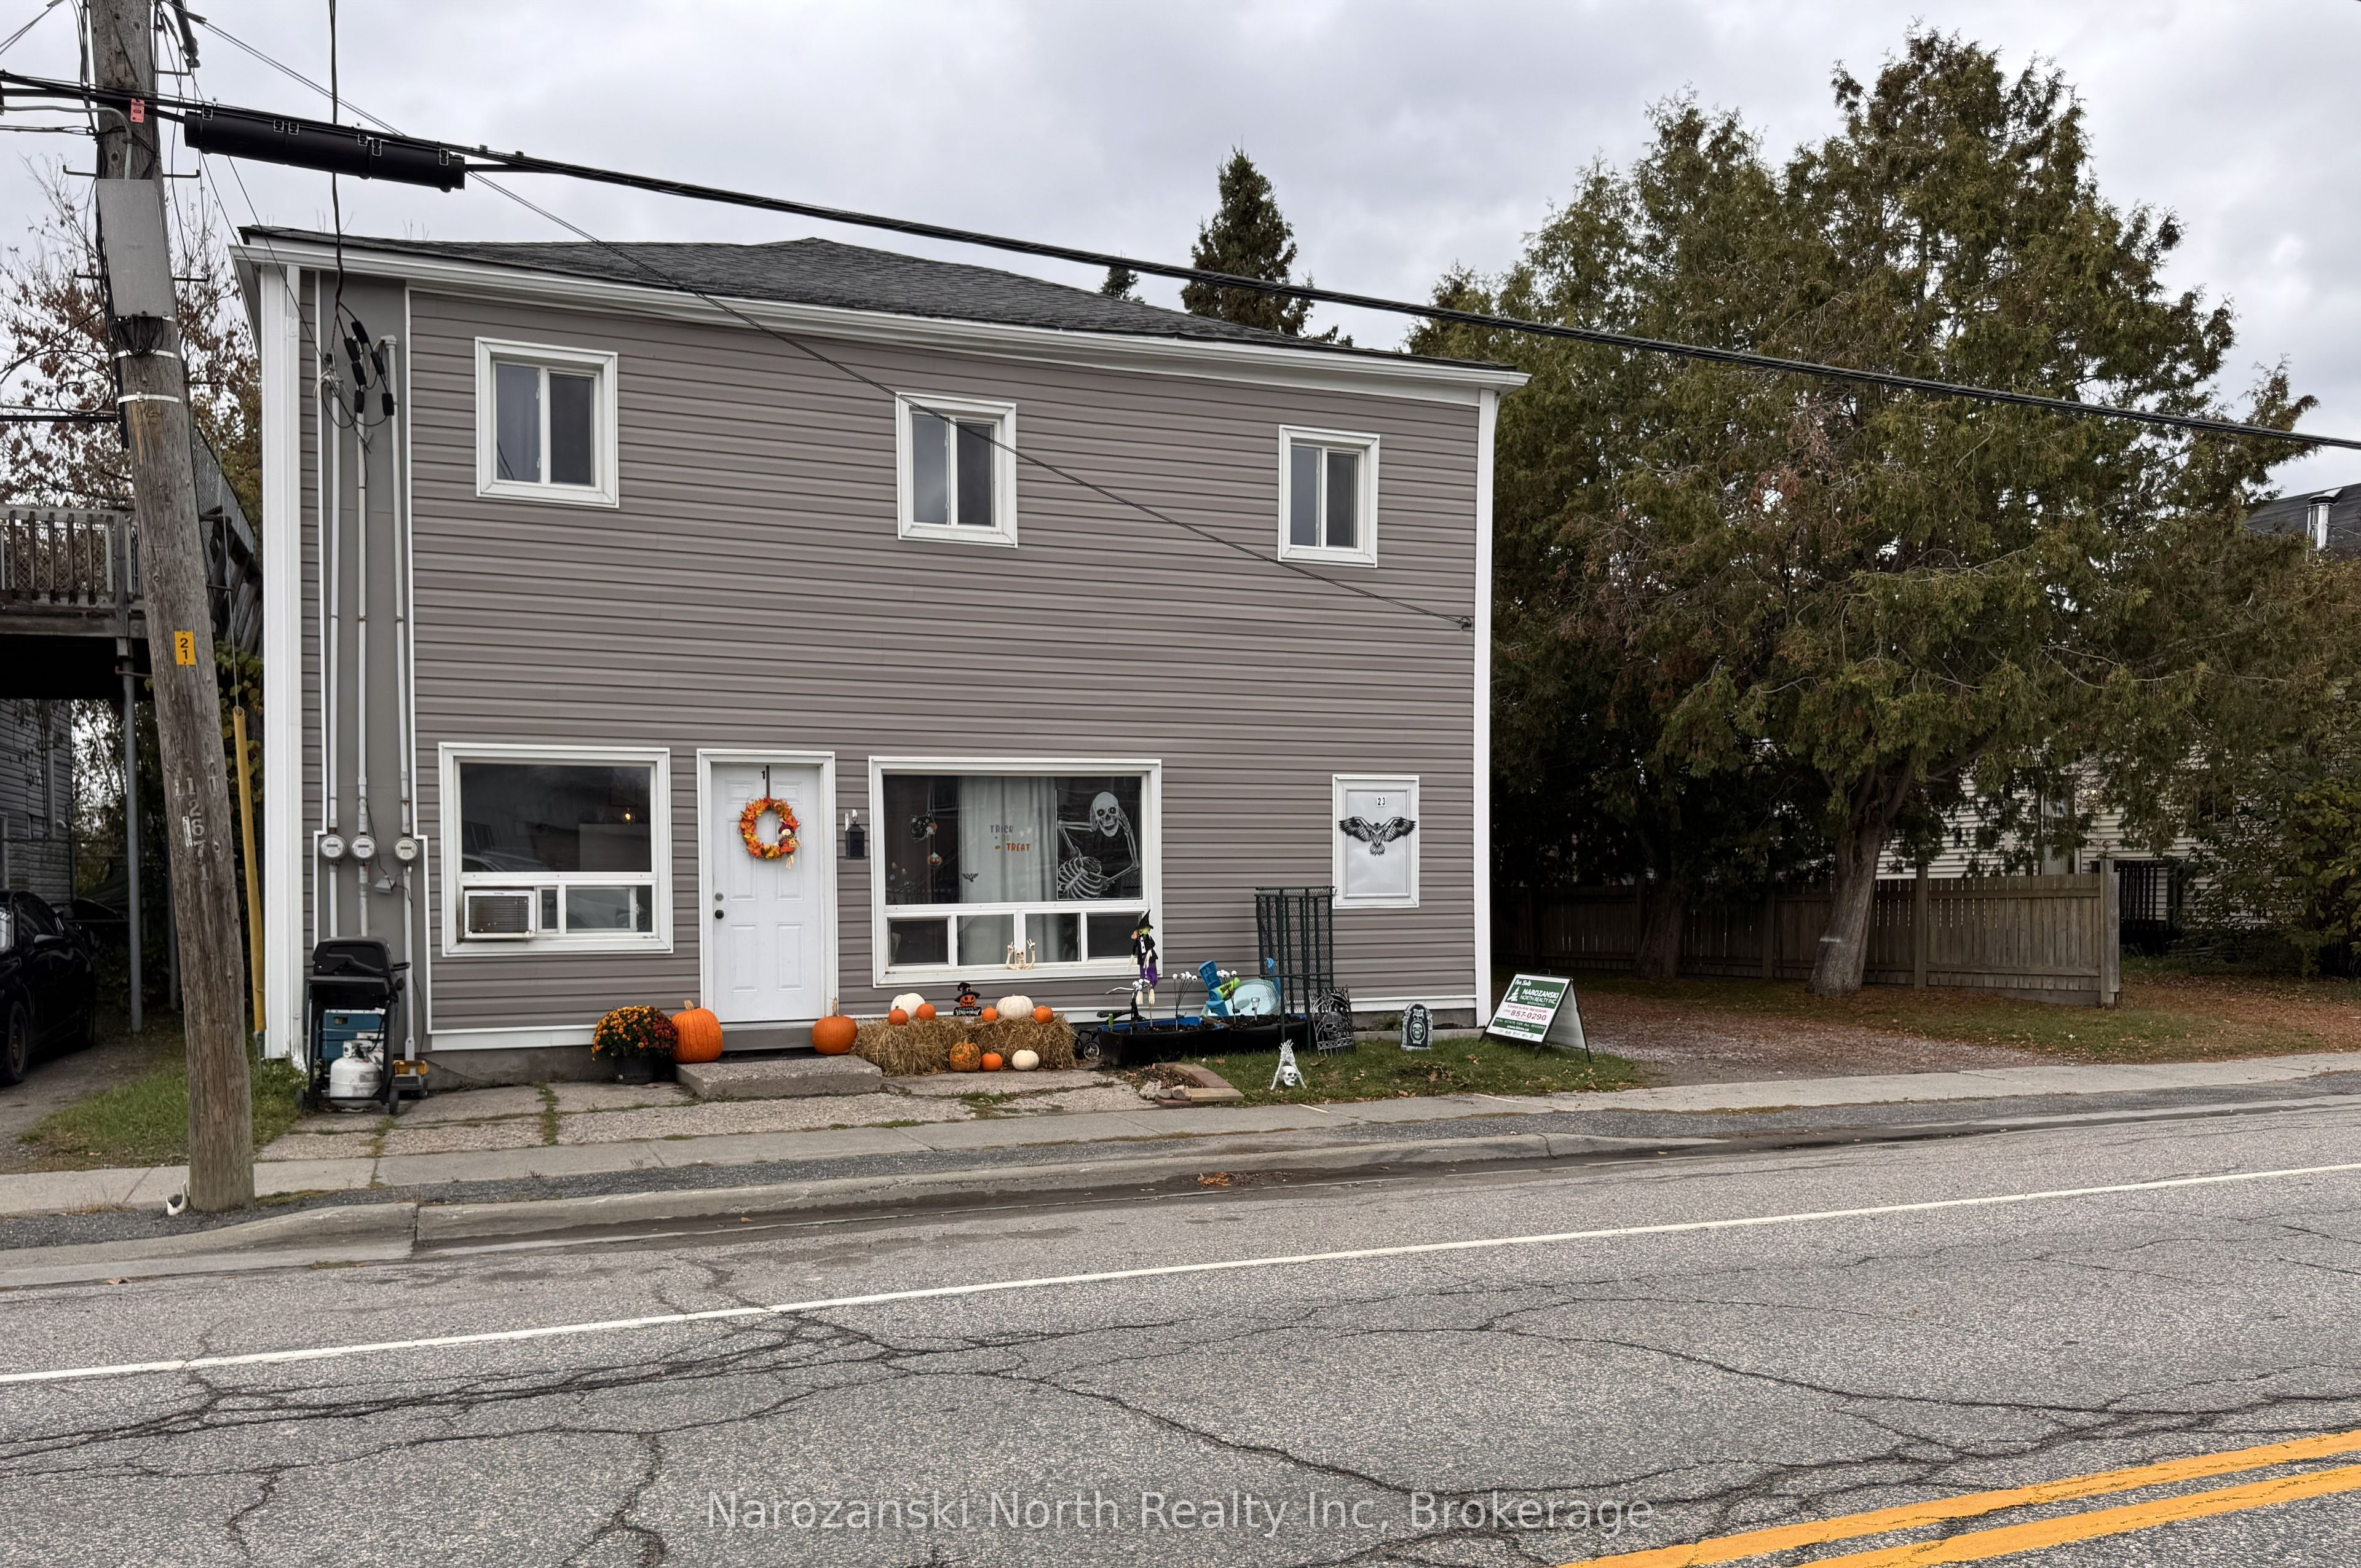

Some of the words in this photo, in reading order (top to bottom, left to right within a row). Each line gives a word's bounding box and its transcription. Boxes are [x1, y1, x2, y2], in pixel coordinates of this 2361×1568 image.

[761, 770, 765, 779] 1
[990, 824, 1013, 833] TRICK
[1006, 843, 1030, 851] TREAT
[1522, 988, 1559, 999] NAROZANSKI
[1511, 1010, 1546, 1020] 857-0290
